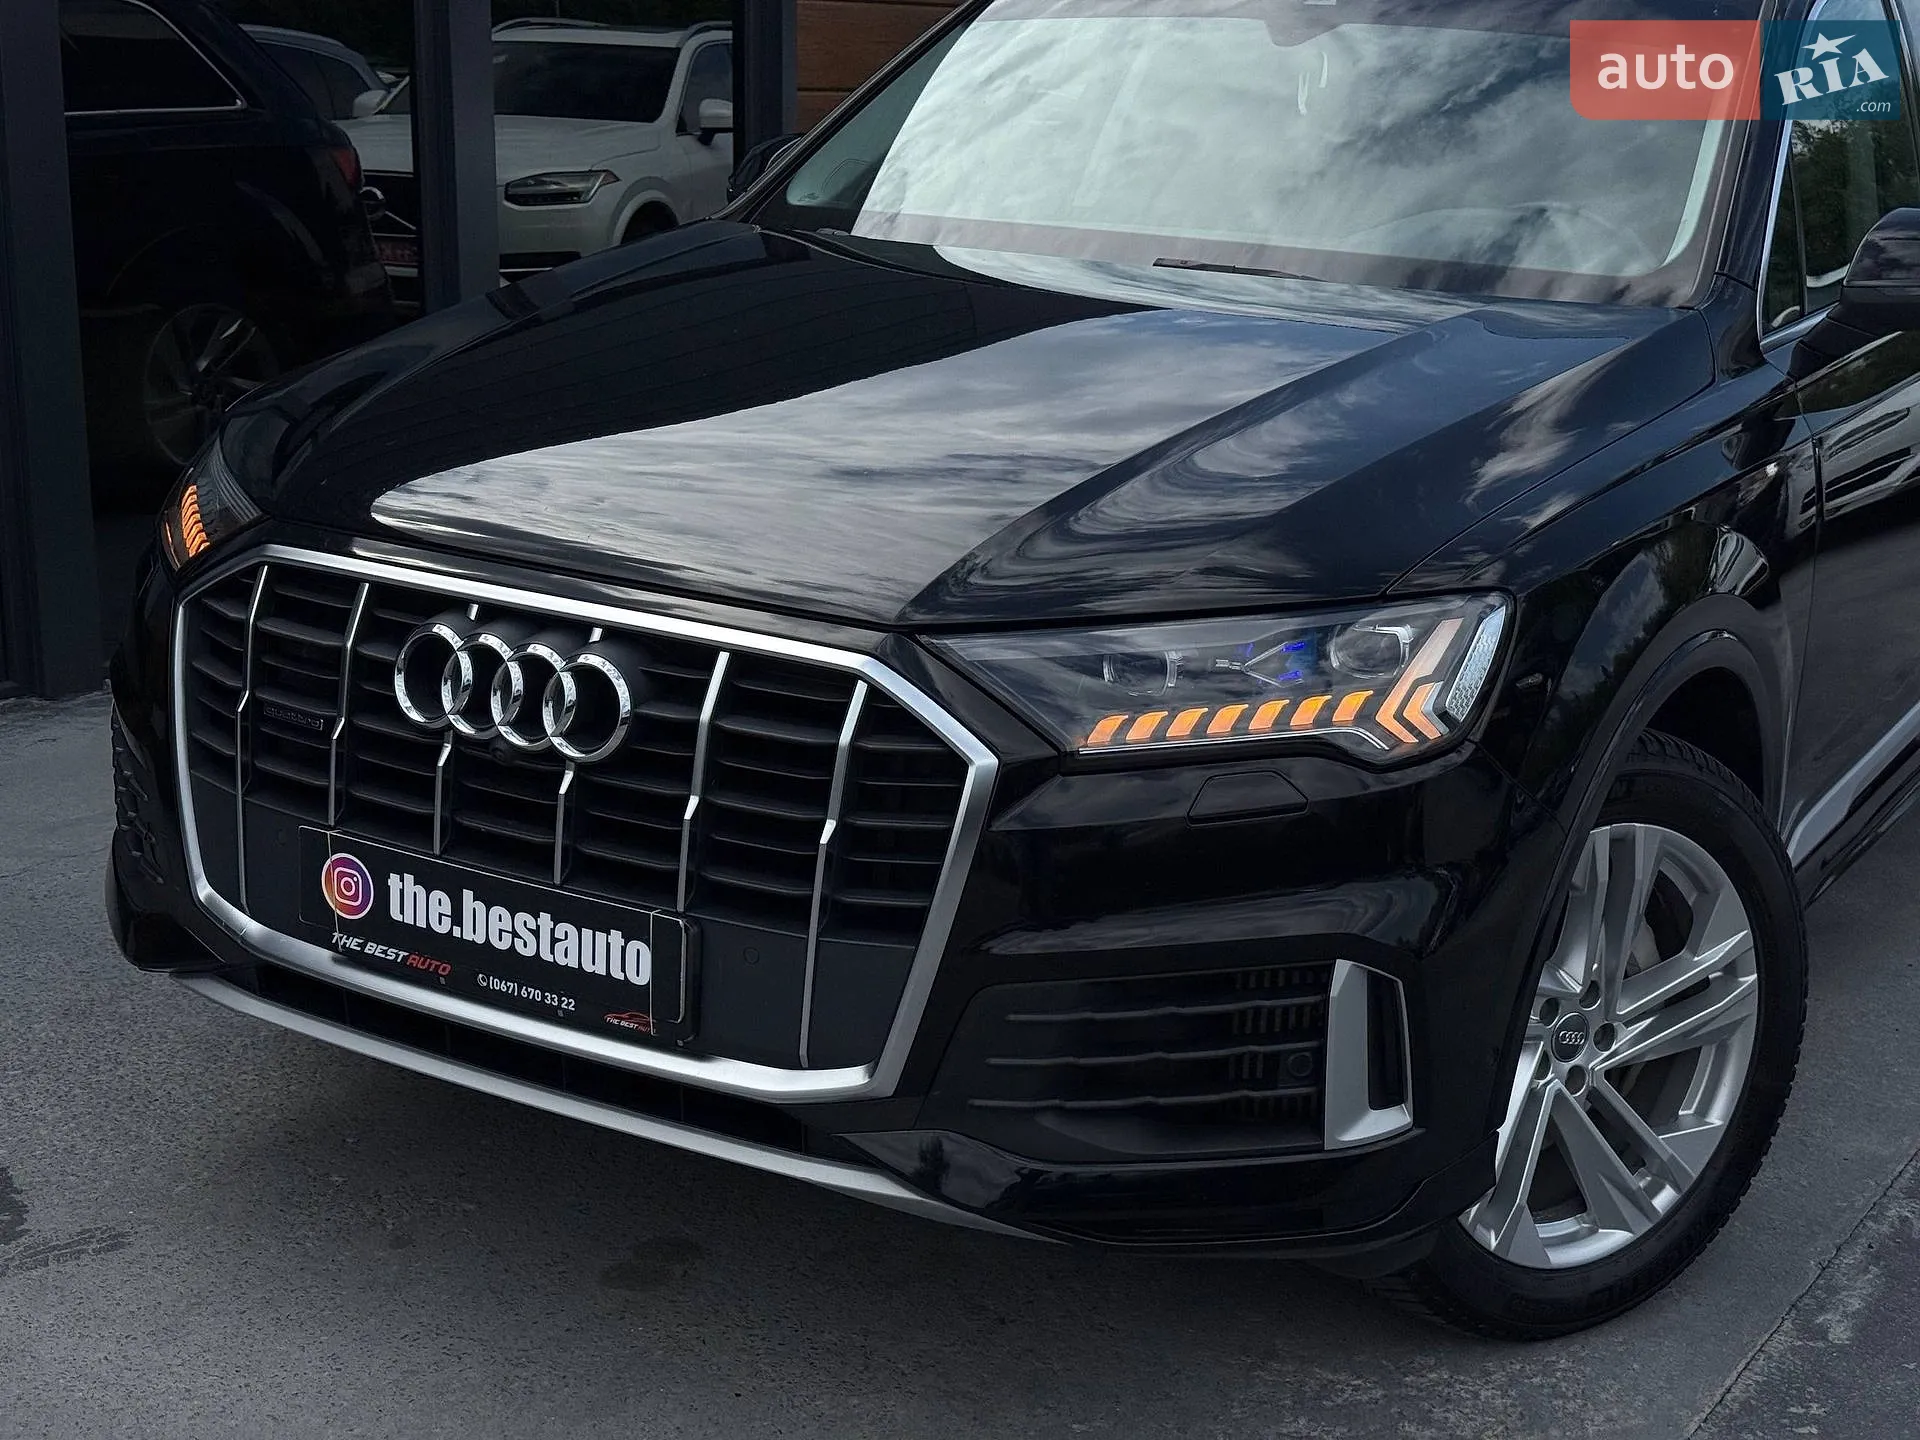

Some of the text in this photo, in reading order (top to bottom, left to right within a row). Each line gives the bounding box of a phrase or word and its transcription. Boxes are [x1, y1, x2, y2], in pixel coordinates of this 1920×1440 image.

[331, 931, 364, 951] THE
[388, 872, 651, 986] the.bestauto
[489, 976, 576, 1011] (067) 670 33 22
